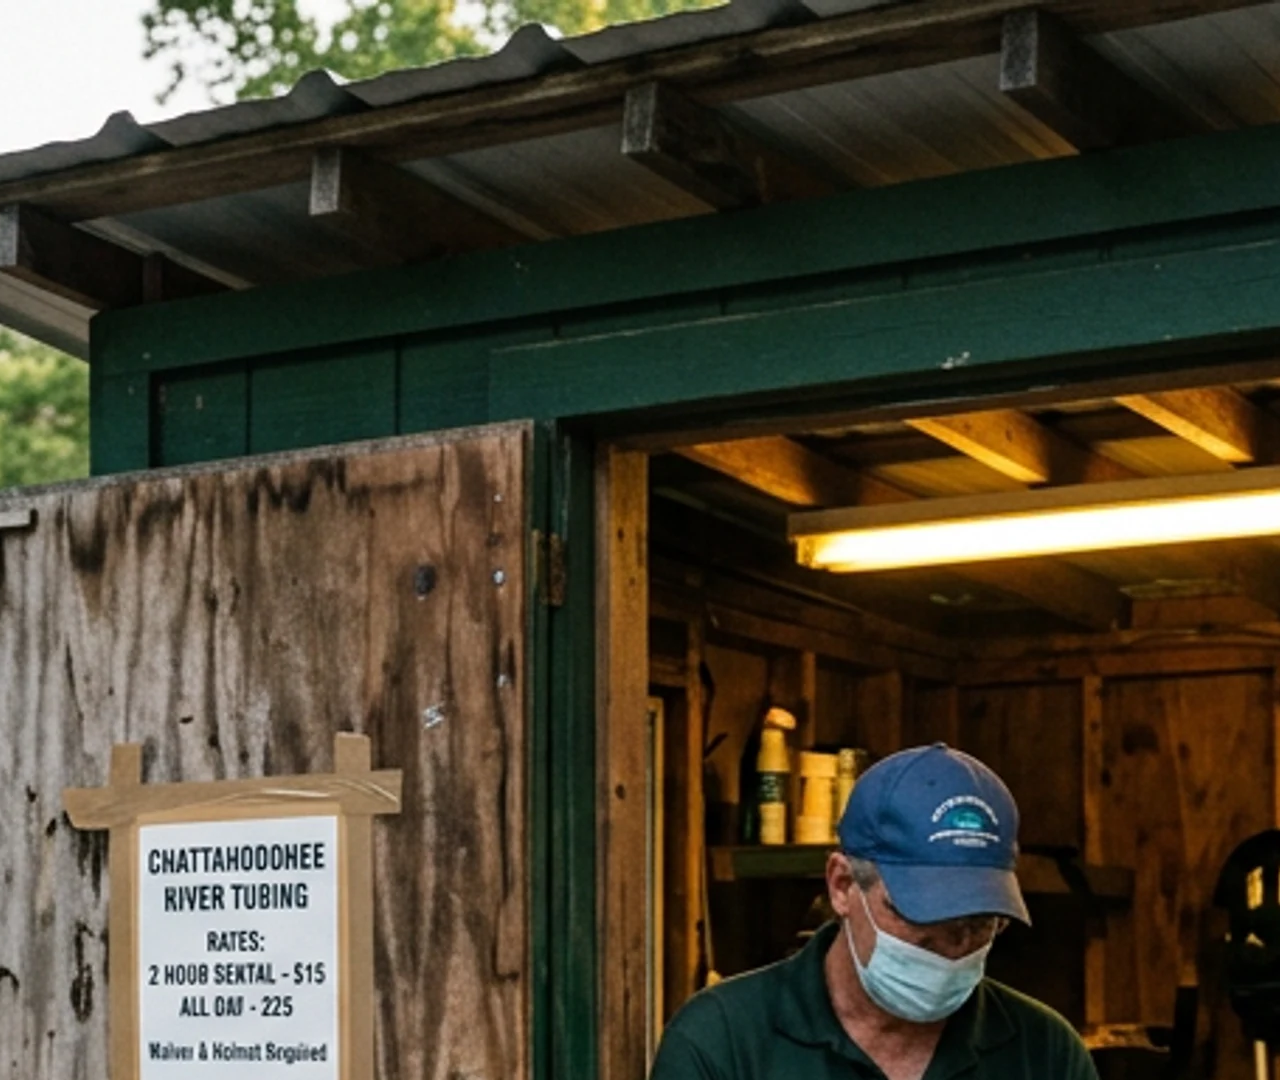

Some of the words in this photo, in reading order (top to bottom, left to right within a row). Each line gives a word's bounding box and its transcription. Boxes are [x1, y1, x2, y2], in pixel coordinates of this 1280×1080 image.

[164, 884, 225, 912] RIVER
[230, 882, 308, 910] TUBING
[207, 930, 265, 952] RATES:
[148, 964, 159, 986] 2
[179, 995, 210, 1017] ALL
[261, 995, 293, 1017] 225
